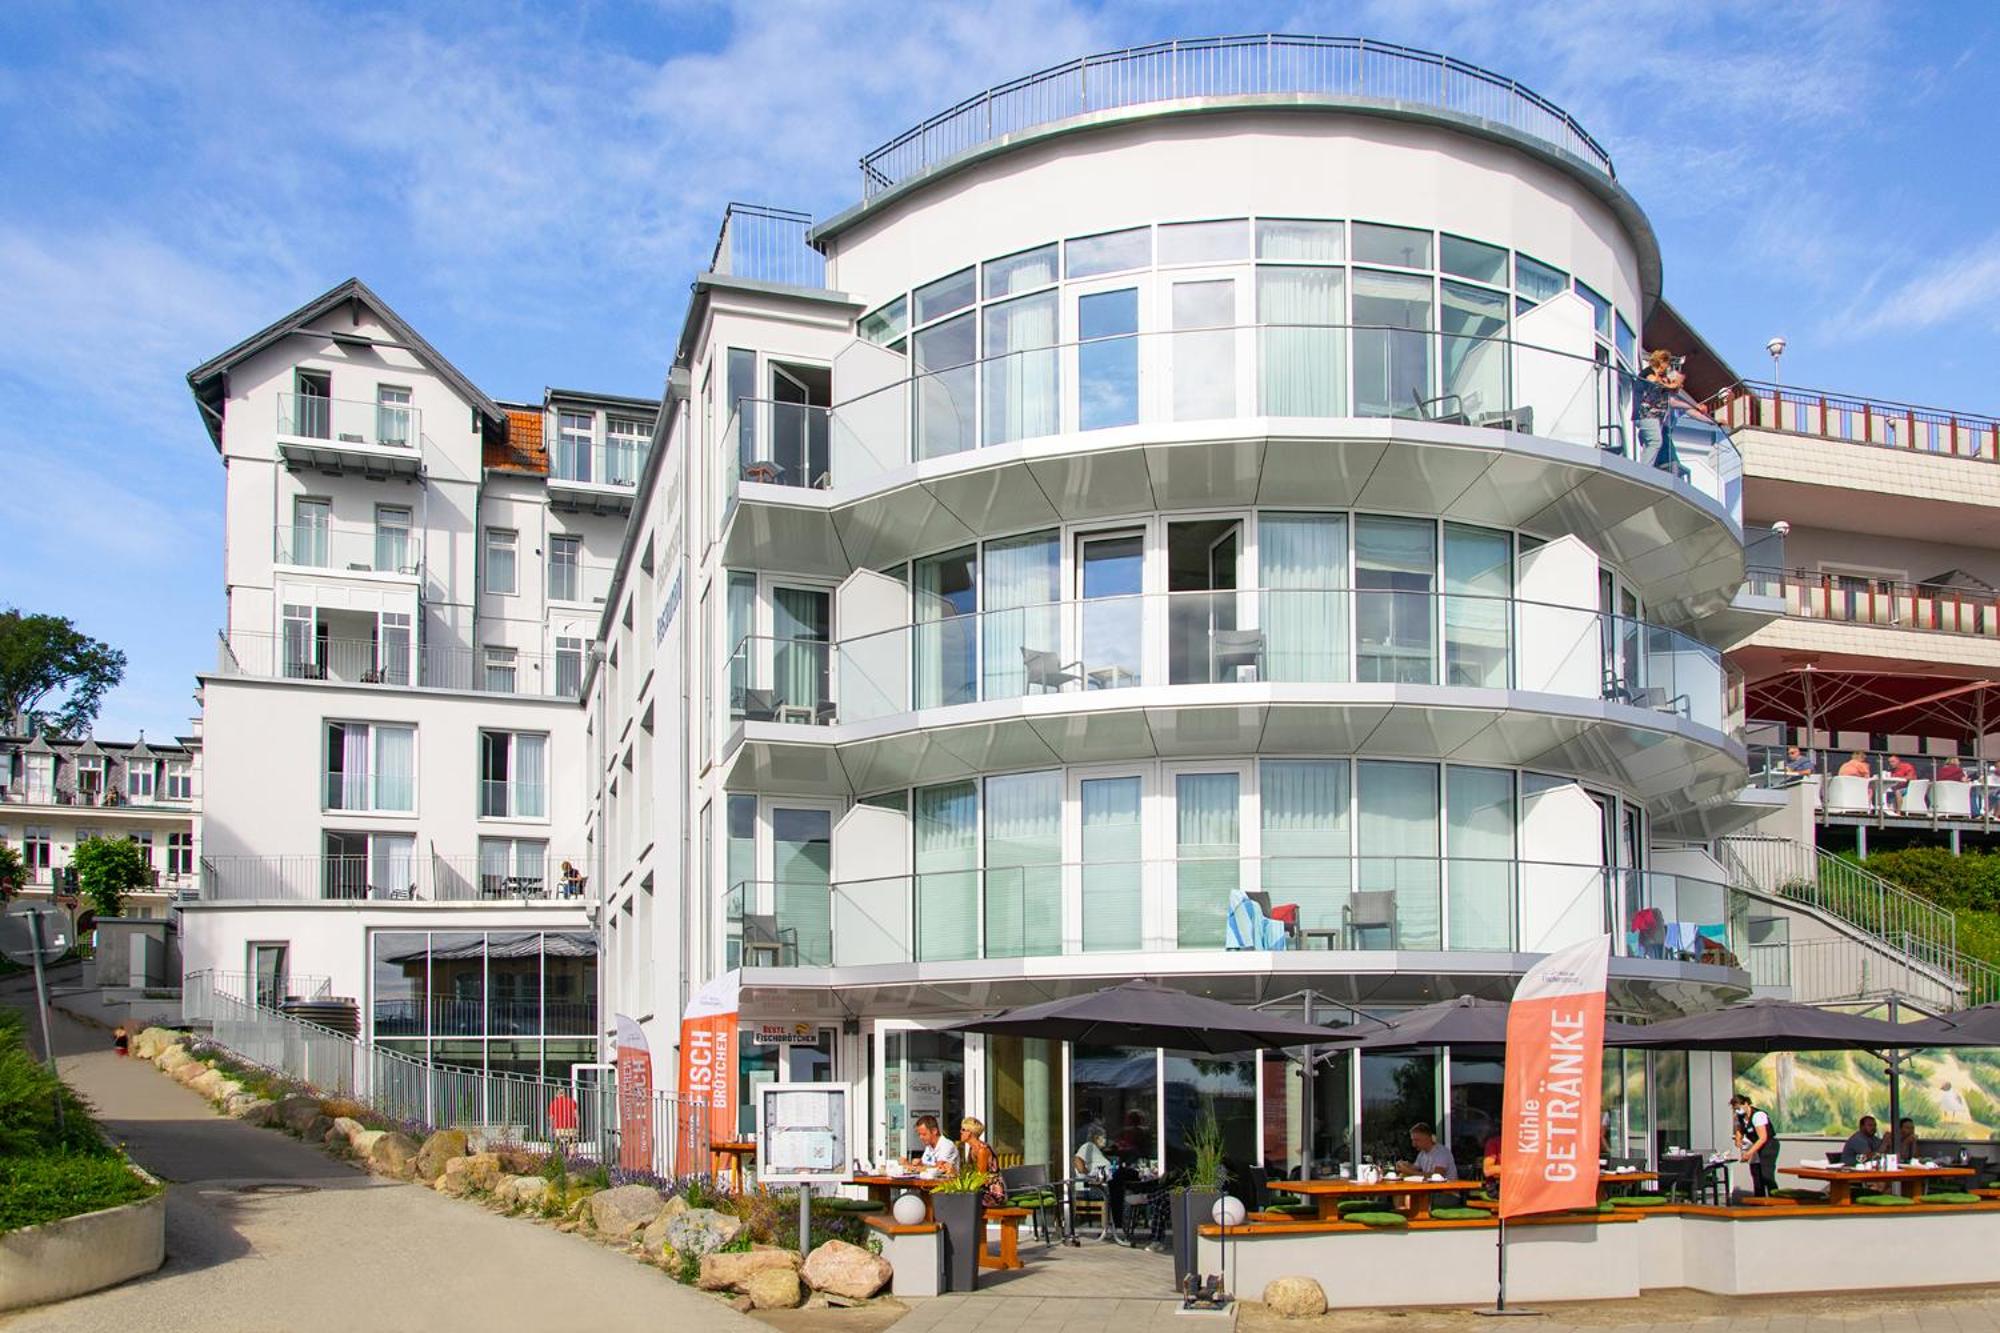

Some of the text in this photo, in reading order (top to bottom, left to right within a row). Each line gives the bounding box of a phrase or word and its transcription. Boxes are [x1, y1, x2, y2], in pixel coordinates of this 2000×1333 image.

[689, 1030, 713, 1108] FISCH
[712, 1031, 729, 1109] BRÖTCHEN
[1538, 1009, 1585, 1182] GETRÄNKE
[1517, 1098, 1541, 1153] Kühle
